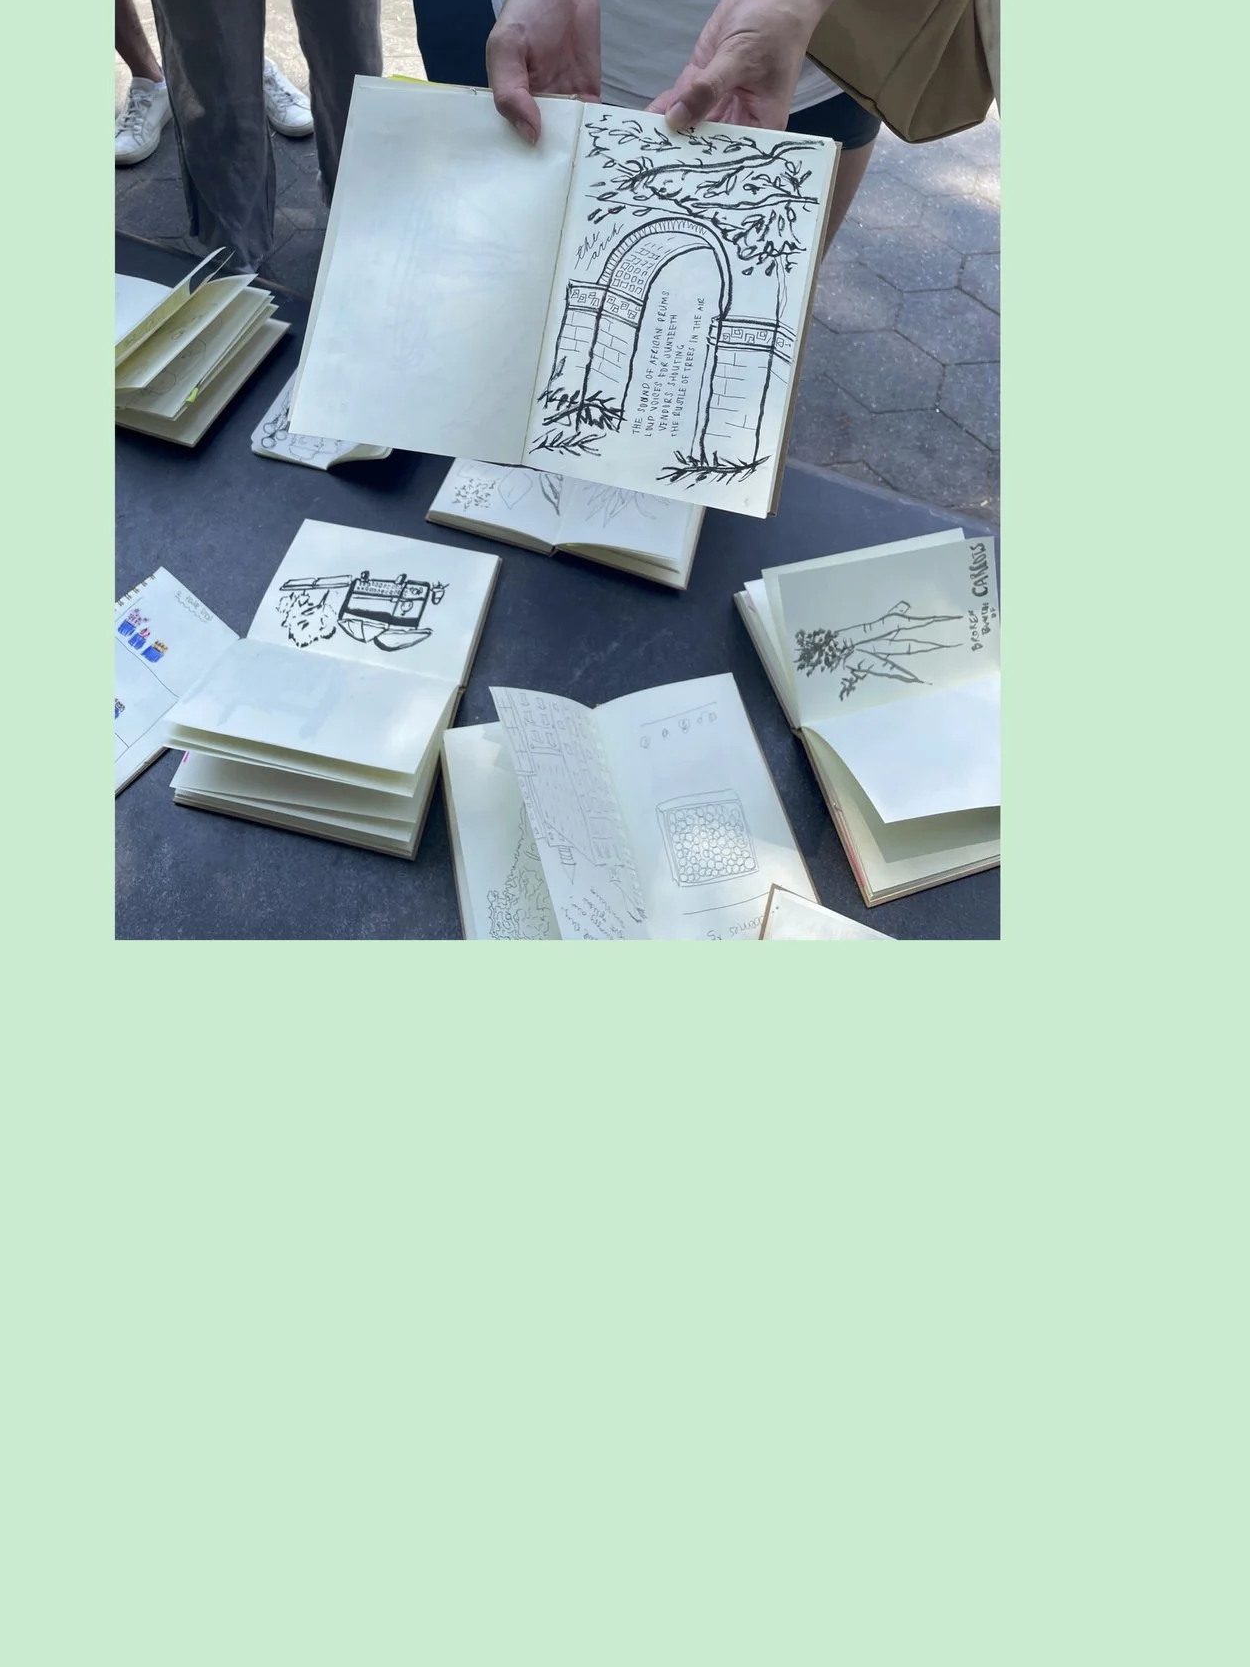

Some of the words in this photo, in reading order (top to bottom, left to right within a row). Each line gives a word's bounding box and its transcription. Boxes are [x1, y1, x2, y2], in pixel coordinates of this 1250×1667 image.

[697, 298, 705, 311] AIR
[693, 315, 702, 330] THE
[649, 327, 663, 365] AFRICAN
[689, 335, 698, 343] IN
[684, 347, 695, 371] TREES
[646, 368, 653, 379] OF
[658, 362, 668, 378] FOR
[659, 392, 673, 431] VENDORS
[668, 344, 684, 386] SHOUTING
[680, 374, 689, 384] OF
[637, 383, 650, 412] SOUND
[672, 388, 687, 416] RUSTLE
[632, 417, 643, 434] THE
[969, 543, 988, 597] CARROTS
